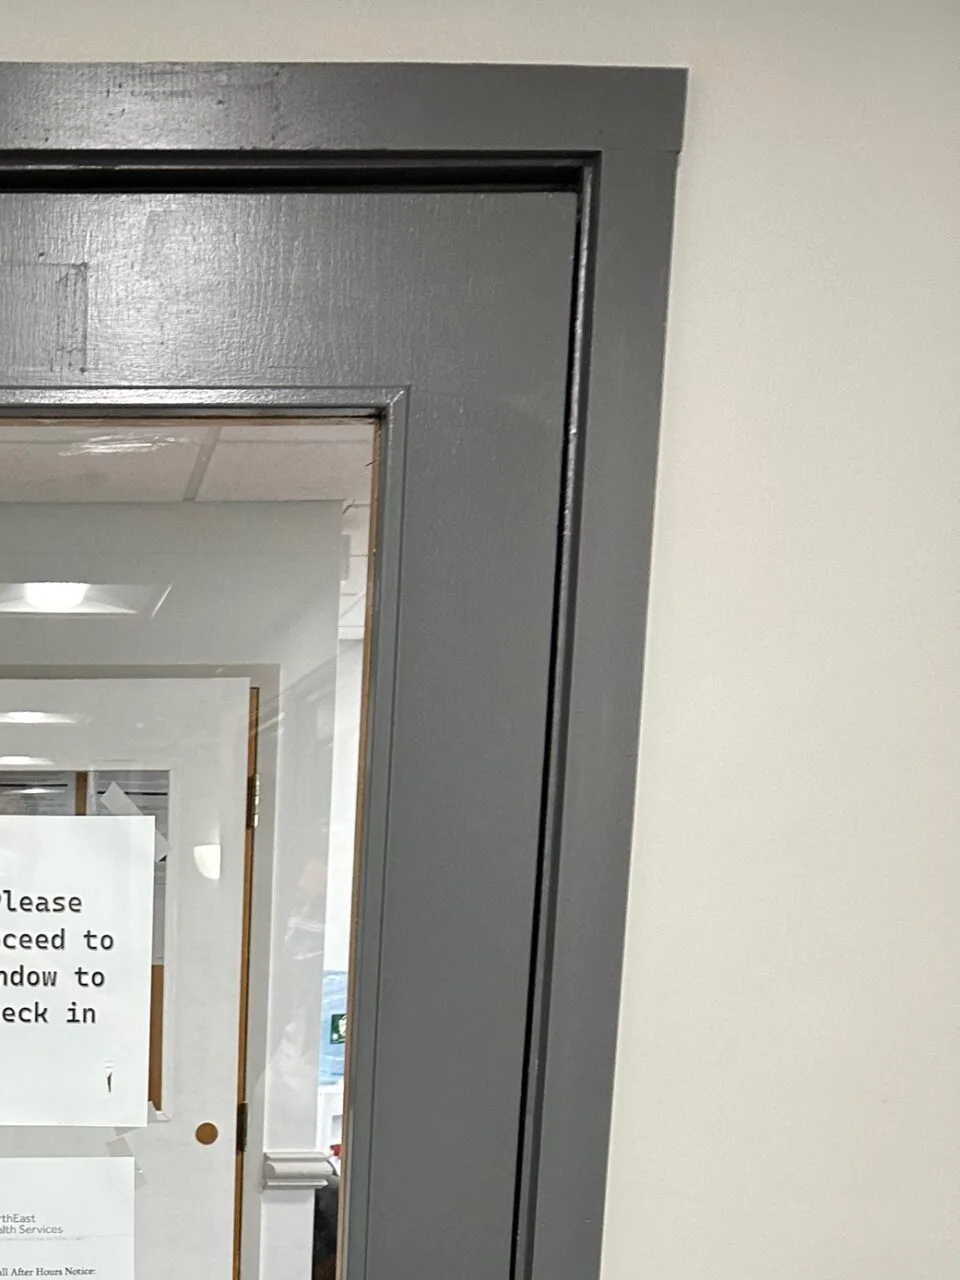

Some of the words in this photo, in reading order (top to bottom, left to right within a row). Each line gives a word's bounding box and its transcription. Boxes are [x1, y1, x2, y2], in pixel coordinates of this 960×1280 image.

[83, 930, 114, 950] to
[74, 967, 105, 987] to
[66, 1002, 96, 1023] in
[19, 1225, 64, 1234] Services
[11, 1267, 33, 1277] After
[36, 1267, 63, 1277] Hours
[65, 1266, 96, 1276] Notice:
